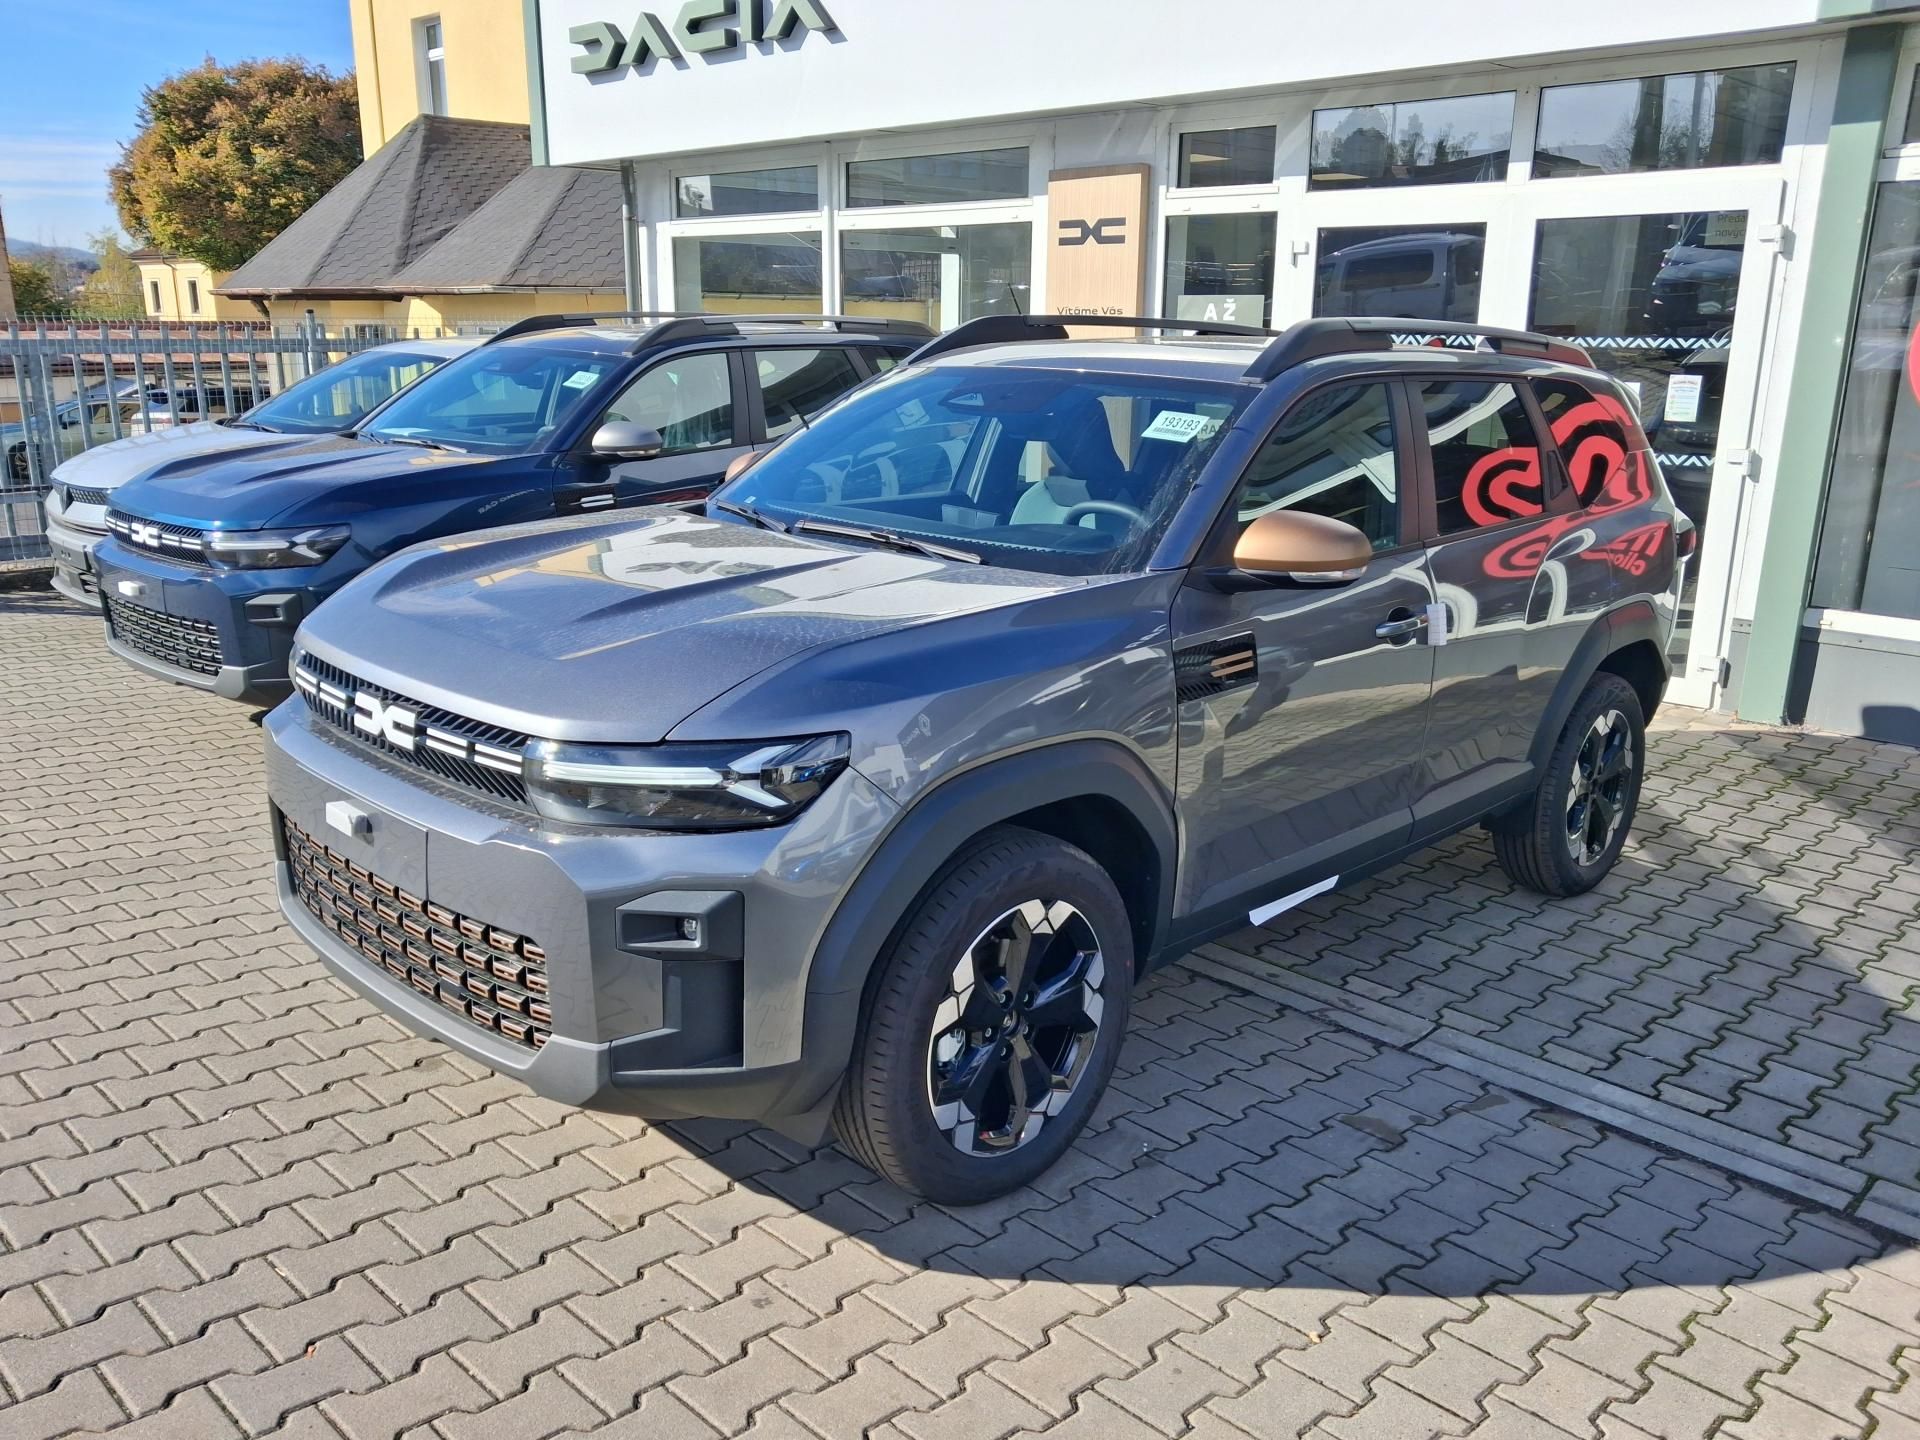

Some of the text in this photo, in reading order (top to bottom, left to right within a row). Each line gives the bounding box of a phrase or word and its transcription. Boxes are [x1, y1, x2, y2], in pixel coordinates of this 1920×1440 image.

[568, 0, 836, 74] DACIA
[1056, 305, 1124, 315] Vítáme Vás
[1161, 416, 1201, 431] 193193
